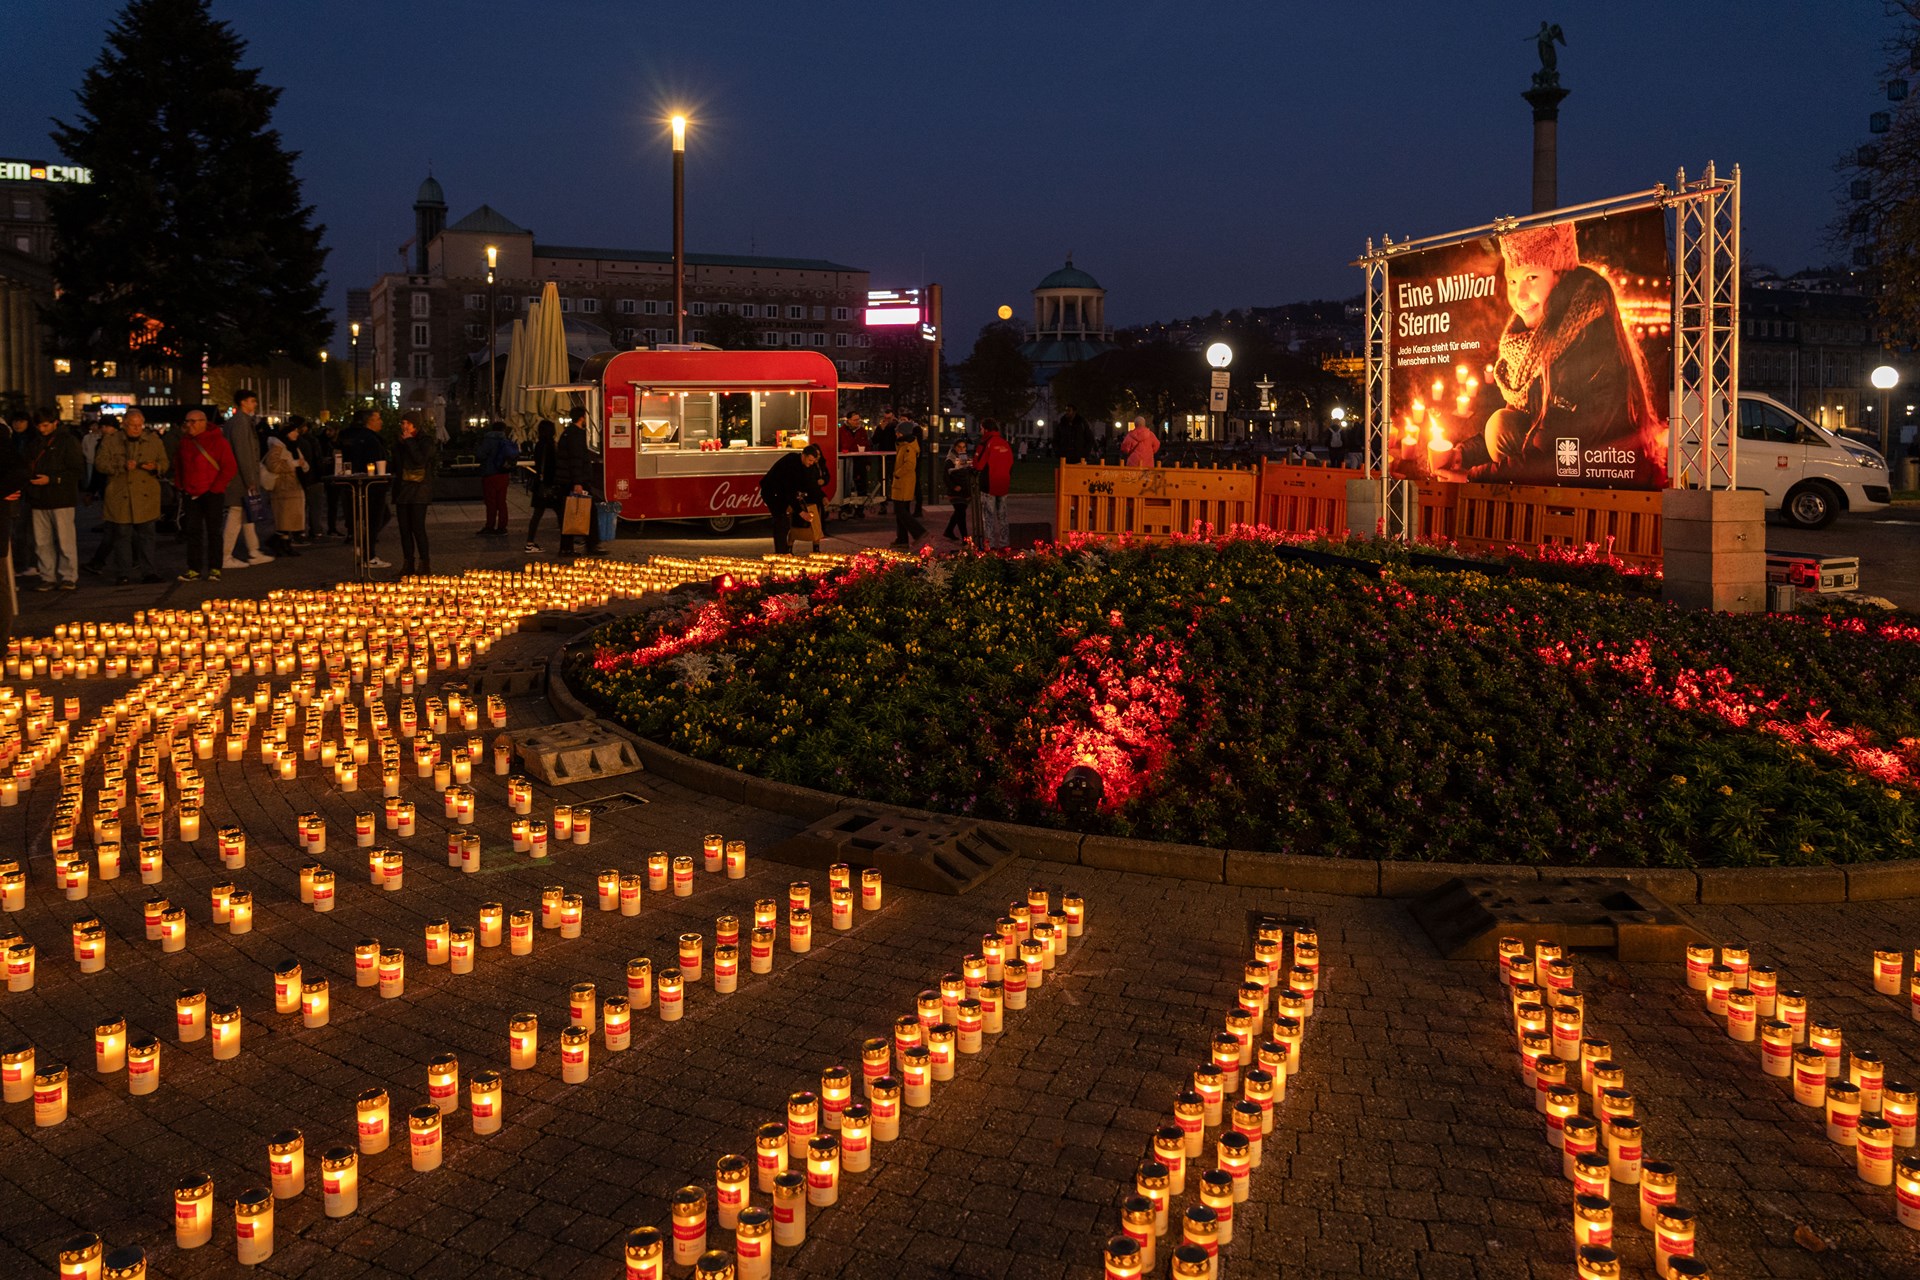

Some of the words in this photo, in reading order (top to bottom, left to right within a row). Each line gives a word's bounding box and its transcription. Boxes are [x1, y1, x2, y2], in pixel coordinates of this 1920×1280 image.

[1398, 282, 1434, 309] Eine
[1436, 272, 1496, 304] Million
[1398, 312, 1450, 338] Sterne
[1397, 346, 1412, 356] Jede
[1412, 344, 1431, 354] Kerze
[1431, 342, 1449, 353] steht
[1449, 341, 1459, 351] für
[1460, 340, 1480, 350] einen
[1397, 356, 1429, 367] Menschen
[1429, 355, 1437, 364] in
[1437, 354, 1450, 364] Not
[1584, 446, 1636, 464] caritas
[1558, 466, 1578, 475] caritas
[1585, 468, 1635, 479] STUTTGART
[710, 481, 767, 511] Carib
